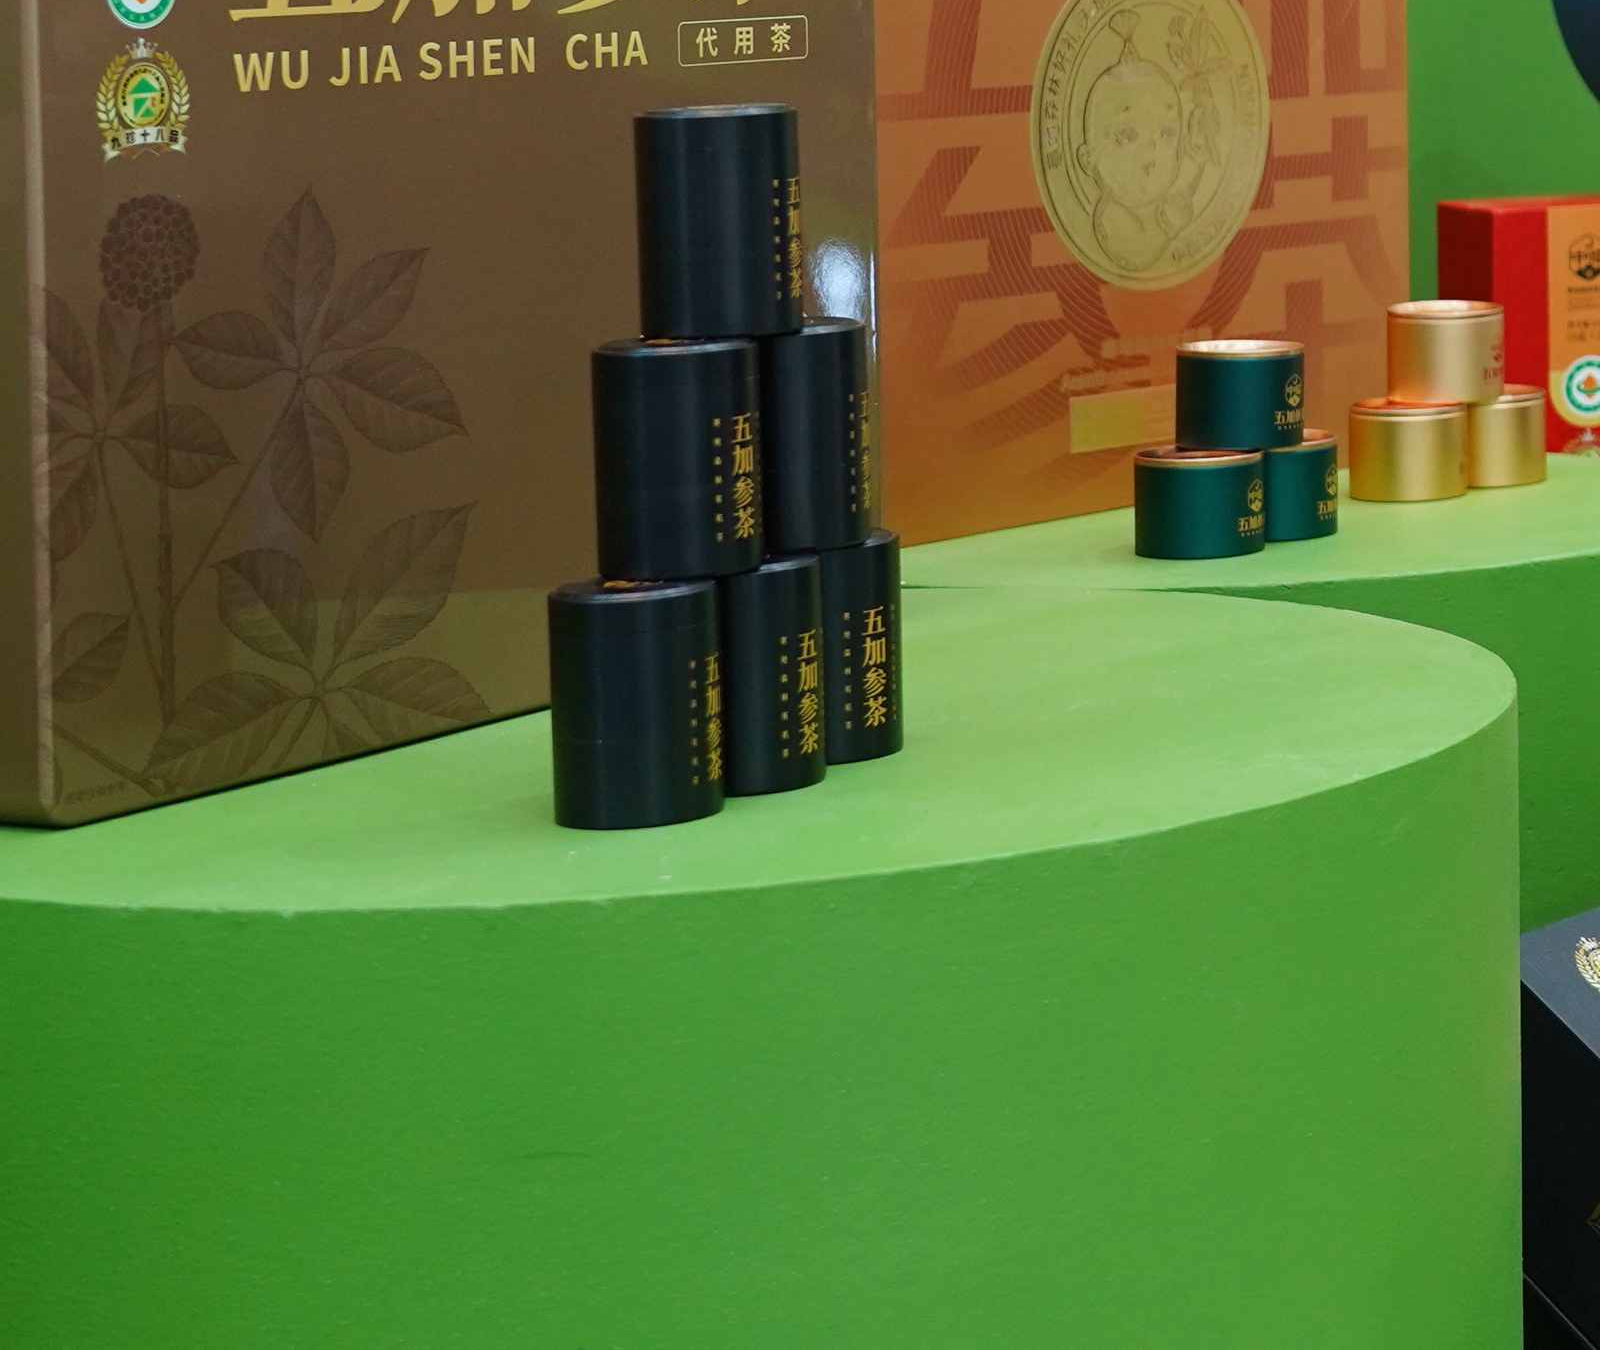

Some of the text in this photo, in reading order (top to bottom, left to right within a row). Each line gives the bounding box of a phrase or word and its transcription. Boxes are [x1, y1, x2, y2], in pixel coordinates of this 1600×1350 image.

[233, 31, 649, 93] WU JIA SHEN CHA
[695, 23, 793, 59] 代用茶
[730, 412, 755, 539] 五加参茶
[704, 652, 723, 780] 五加参茶
[797, 629, 819, 755] 五加参茶
[862, 606, 887, 728] 五加参茶
